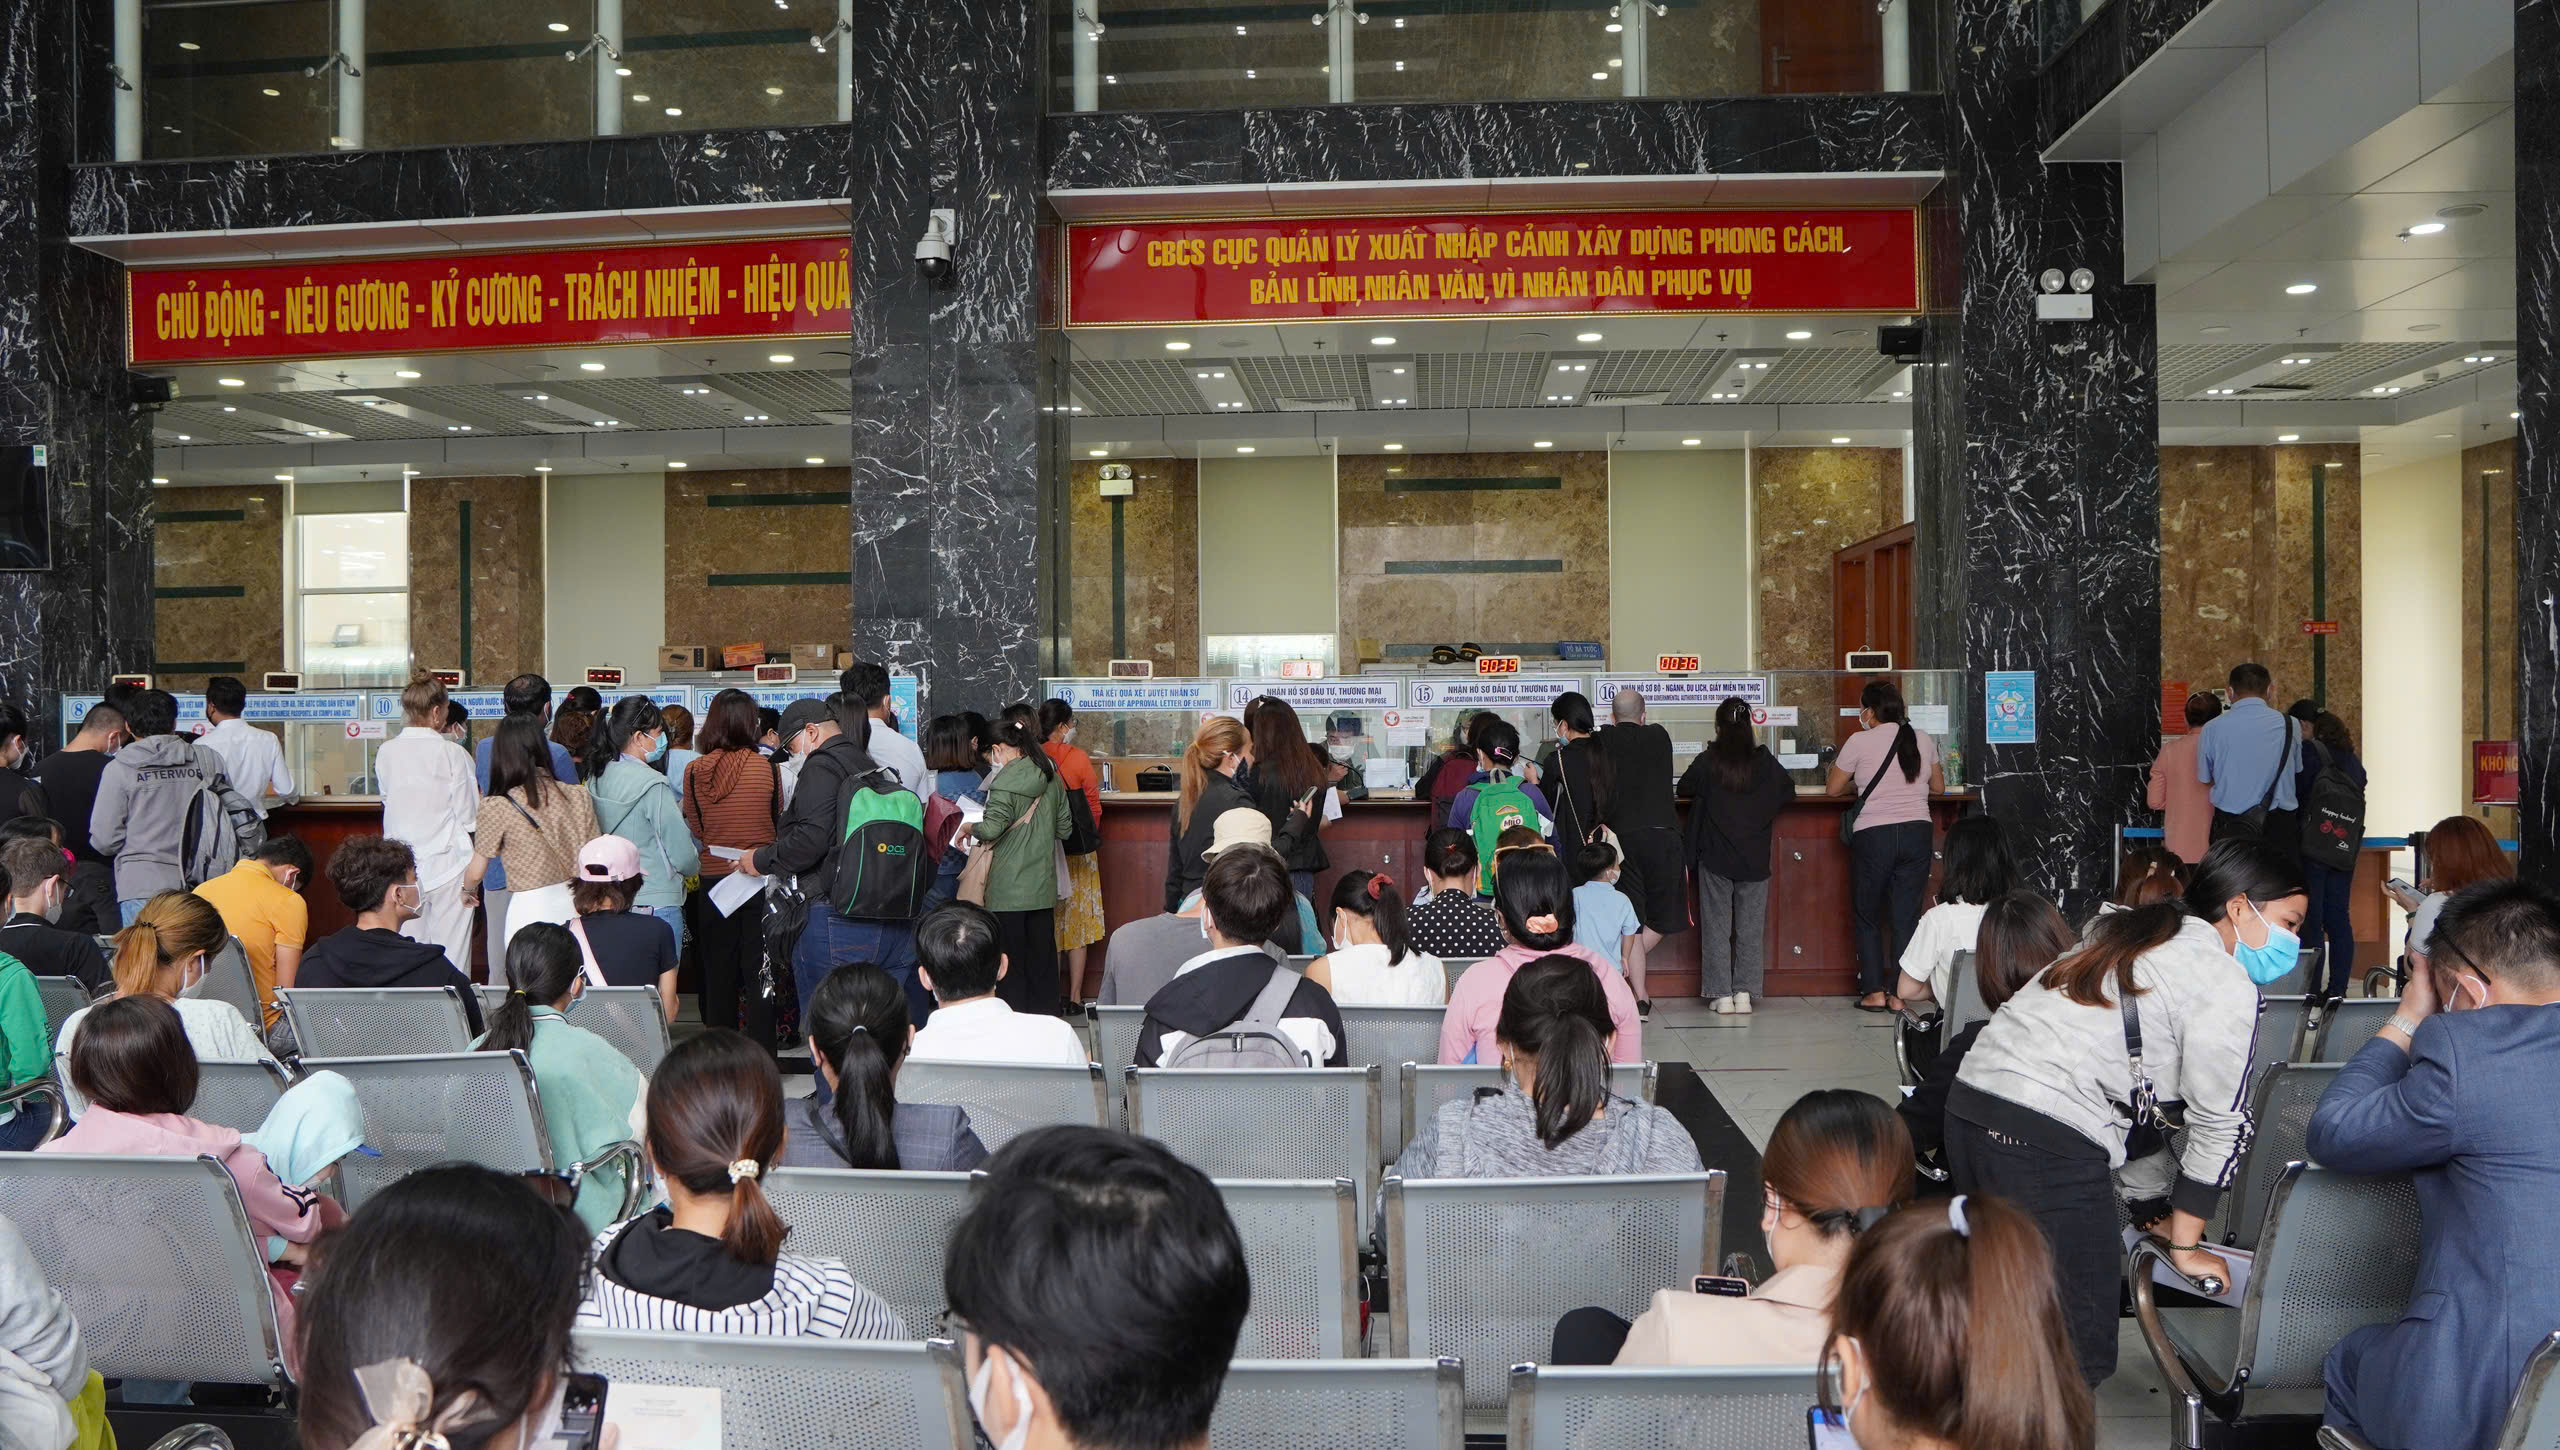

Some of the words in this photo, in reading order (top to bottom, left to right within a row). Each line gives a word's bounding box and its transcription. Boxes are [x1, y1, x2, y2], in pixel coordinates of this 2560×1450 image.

[1147, 238, 1206, 267] CBCS
[1212, 237, 1258, 270] CỤC
[1265, 228, 1329, 267] QUẢN
[1336, 229, 1360, 262] LÝ
[1368, 225, 1427, 261] XUẤT
[1435, 227, 1498, 264] NHẬP
[1506, 223, 1569, 257] CẢNH
[1576, 224, 1622, 256] XÂY
[1631, 225, 1693, 261] DỰNG
[1700, 226, 1775, 254] PHONG
[1250, 270, 1299, 305] BẢN
[1365, 270, 1429, 302] NHÂN
[1492, 267, 1515, 298] VÌ
[1522, 266, 1588, 298] NHÂN
[1595, 265, 1644, 297] DÂN
[1651, 268, 1712, 300] PHỤC
[1720, 268, 1751, 300] VỤ
[157, 280, 199, 340] CHỦ
[205, 280, 265, 347] ĐỘNG
[285, 276, 328, 334] NÊU
[336, 278, 410, 332] GƯƠNG
[431, 267, 460, 327] KỶ
[466, 272, 542, 327] CƯƠNG
[565, 262, 637, 321] TRÁCH
[645, 257, 720, 325] NHIỆM
[744, 253, 797, 321] HIỆU
[805, 248, 851, 317] QUẢ
[1480, 659, 1517, 673] 9039
[1661, 657, 1697, 670] 0036
[1134, 687, 1146, 697] XÉT
[1148, 687, 1168, 699] DUYỆT
[1170, 687, 1188, 697] NHÂN
[1299, 687, 1309, 695] SƠ
[1339, 687, 1366, 695] THƯƠNG
[1368, 687, 1382, 697] MẠI
[1418, 687, 1430, 701] 15
[1480, 685, 1490, 693] SƠ
[1520, 684, 1548, 693] THƯƠNG
[1550, 684, 1564, 695] MẠI
[1603, 685, 1615, 700] 16
[1687, 684, 1694, 692] DU
[1738, 683, 1746, 693] THỊ
[1747, 682, 1761, 693] THỰC
[787, 692, 797, 701] CHO
[1060, 689, 1072, 705] 13
[1237, 689, 1249, 703] 14
[75, 703, 83, 717] 8
[379, 700, 390, 714] 10
[1079, 699, 1116, 708] COLLECTION
[1117, 699, 1126, 708] OF
[1127, 699, 1158, 708] APPROVAL
[1160, 699, 1182, 708] LETTER
[1183, 699, 1191, 707] OF
[1192, 699, 1212, 707] ENTRY
[2480, 752, 2519, 773] KHÔNG
[1503, 818, 1521, 827] MILO
[887, 845, 905, 853] OCB
